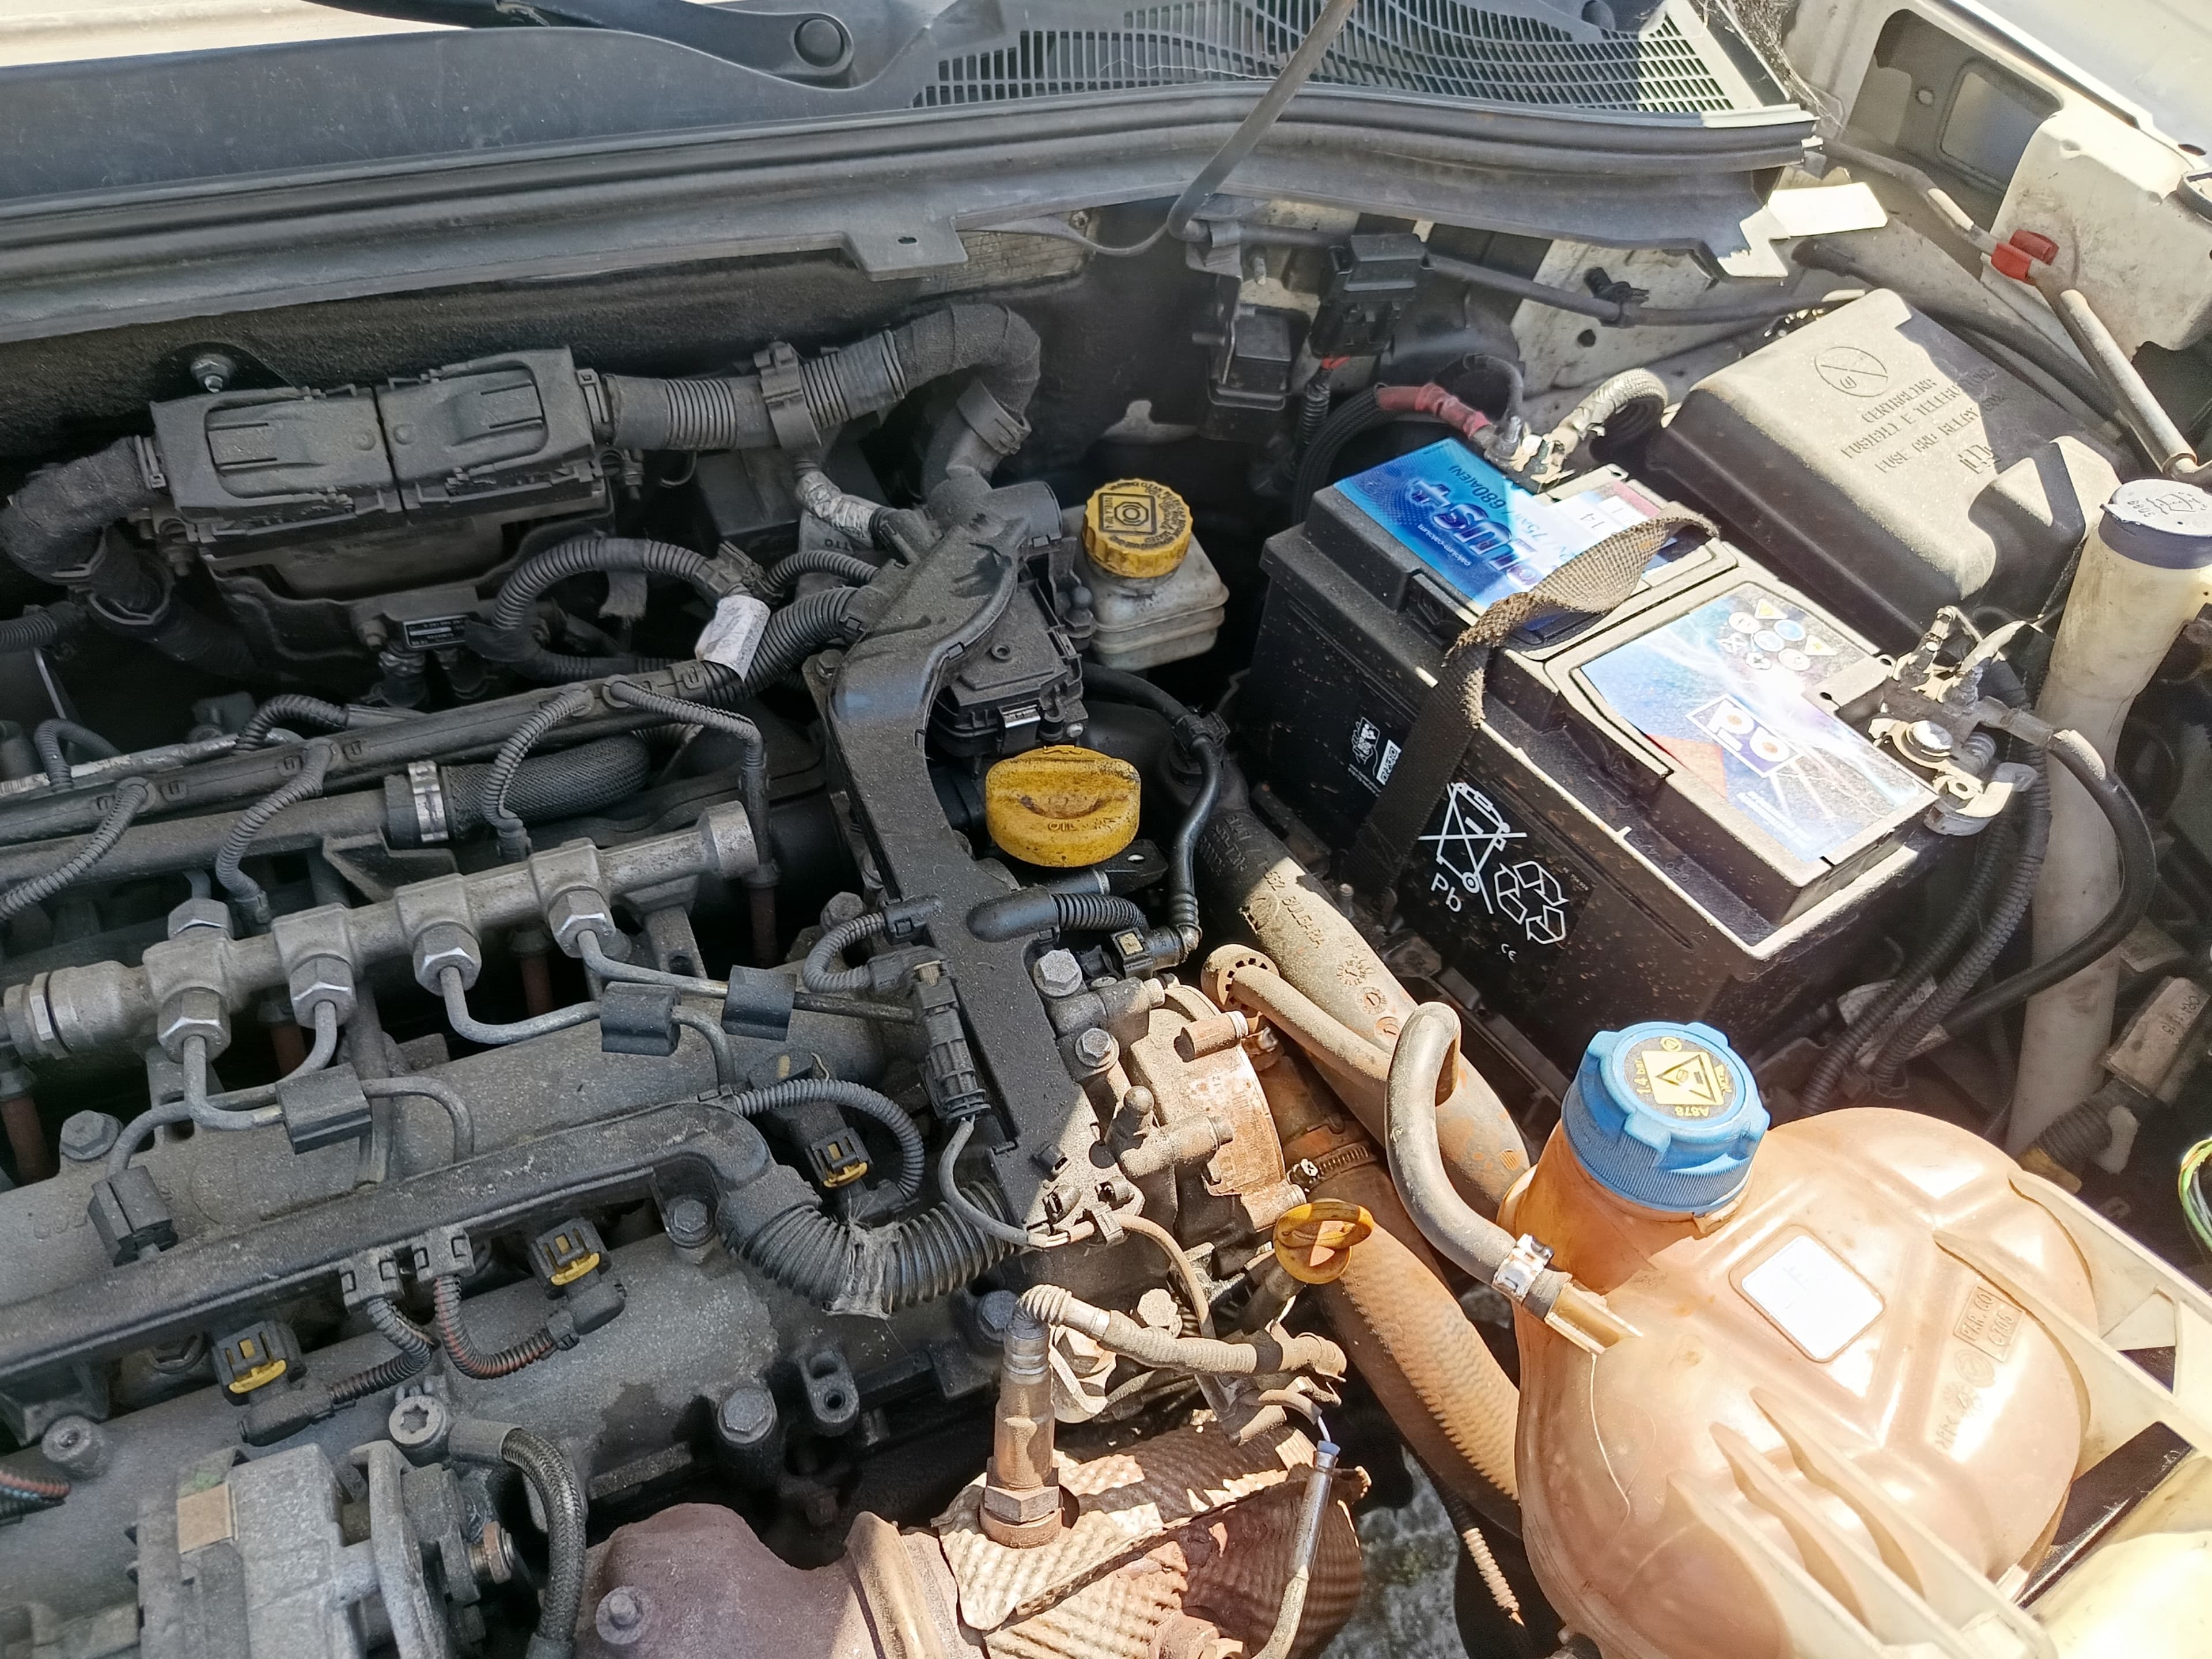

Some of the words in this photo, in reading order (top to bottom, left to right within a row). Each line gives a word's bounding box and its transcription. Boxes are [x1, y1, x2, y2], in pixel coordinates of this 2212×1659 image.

[1861, 376, 1938, 424] CENTRALINA
[1840, 421, 1902, 459] FUSIBILI
[1902, 411, 1918, 423] E
[1874, 449, 1911, 474] FUSE
[1911, 432, 1940, 452] AND
[1938, 407, 1982, 436] RELAY
[1104, 497, 1112, 514] TUTELA
[1447, 465, 1507, 512] 680A(EN)
[1416, 522, 1471, 567] calcium-calcium
[1048, 821, 1077, 831] OIL
[1430, 872, 1463, 913] Pb
[1674, 1106, 1709, 1116] A878
